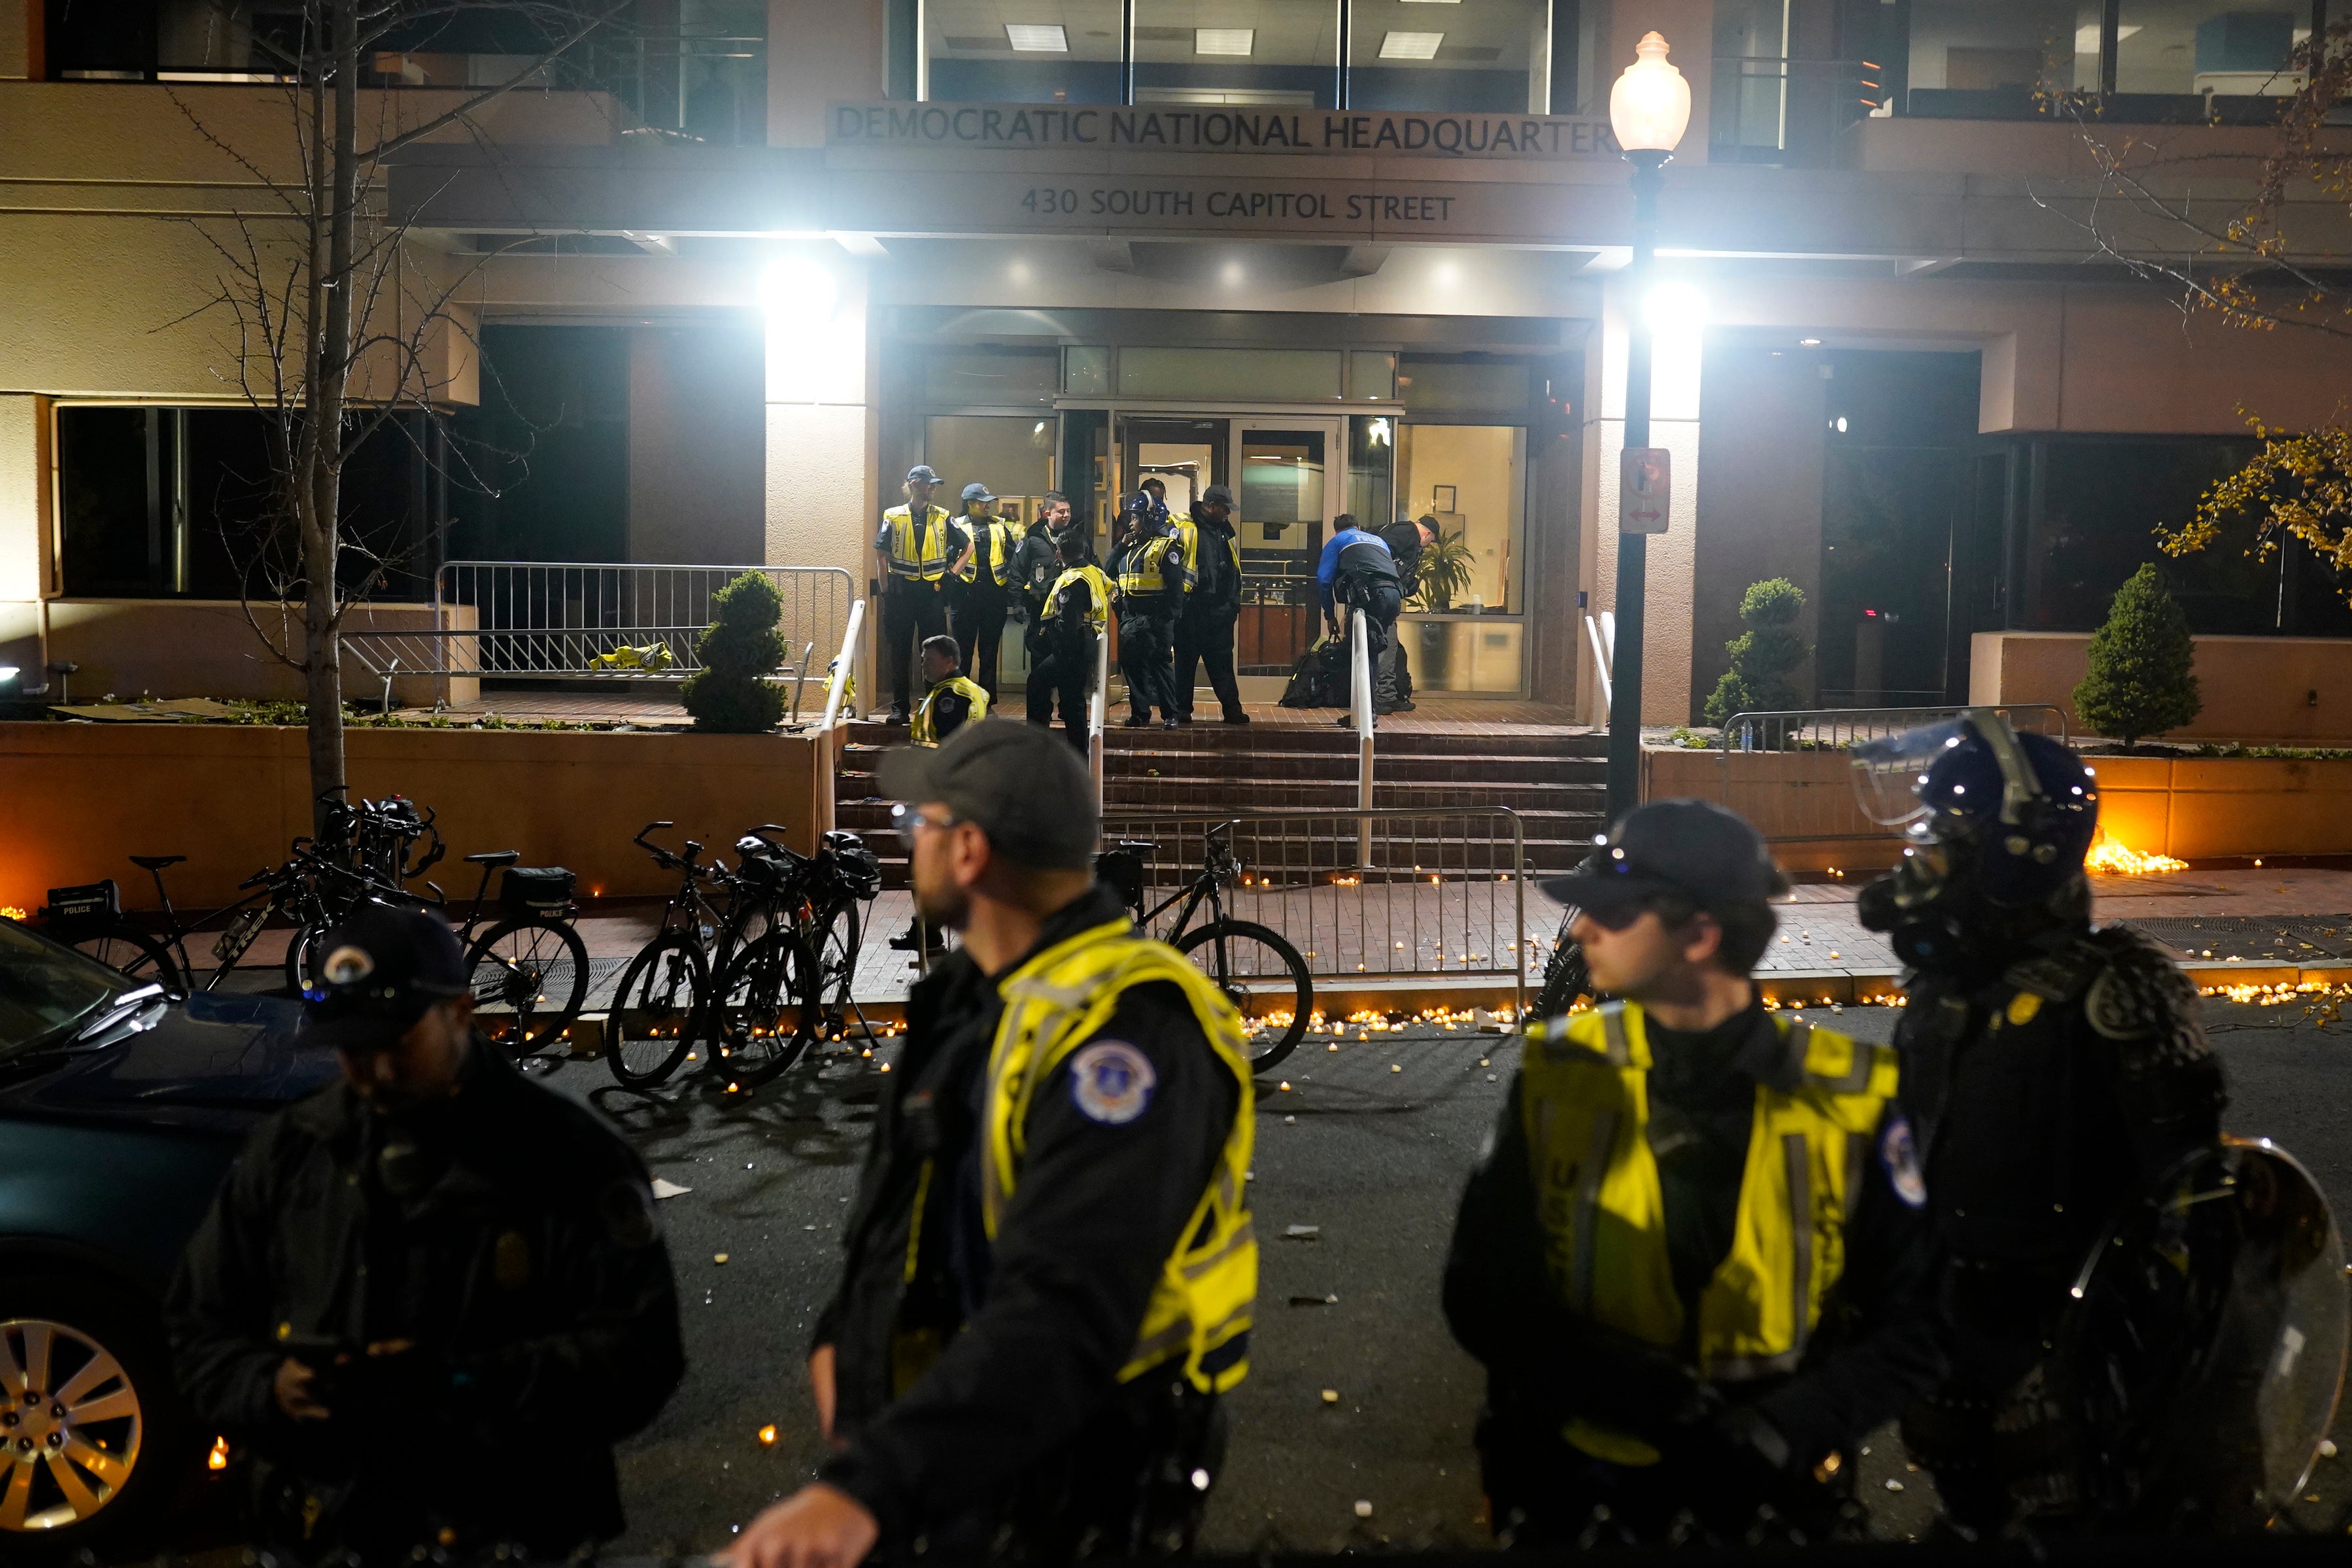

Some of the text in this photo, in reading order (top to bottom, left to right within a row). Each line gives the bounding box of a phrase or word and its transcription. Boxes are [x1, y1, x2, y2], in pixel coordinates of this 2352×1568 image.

[835, 107, 1624, 156] DEMOCRATIC NATIONAL HEADQUARTER
[1021, 189, 1456, 221] 430 SOUTH CAPITOL STREET
[64, 906, 91, 915] POLICE
[231, 900, 276, 959] TREK
